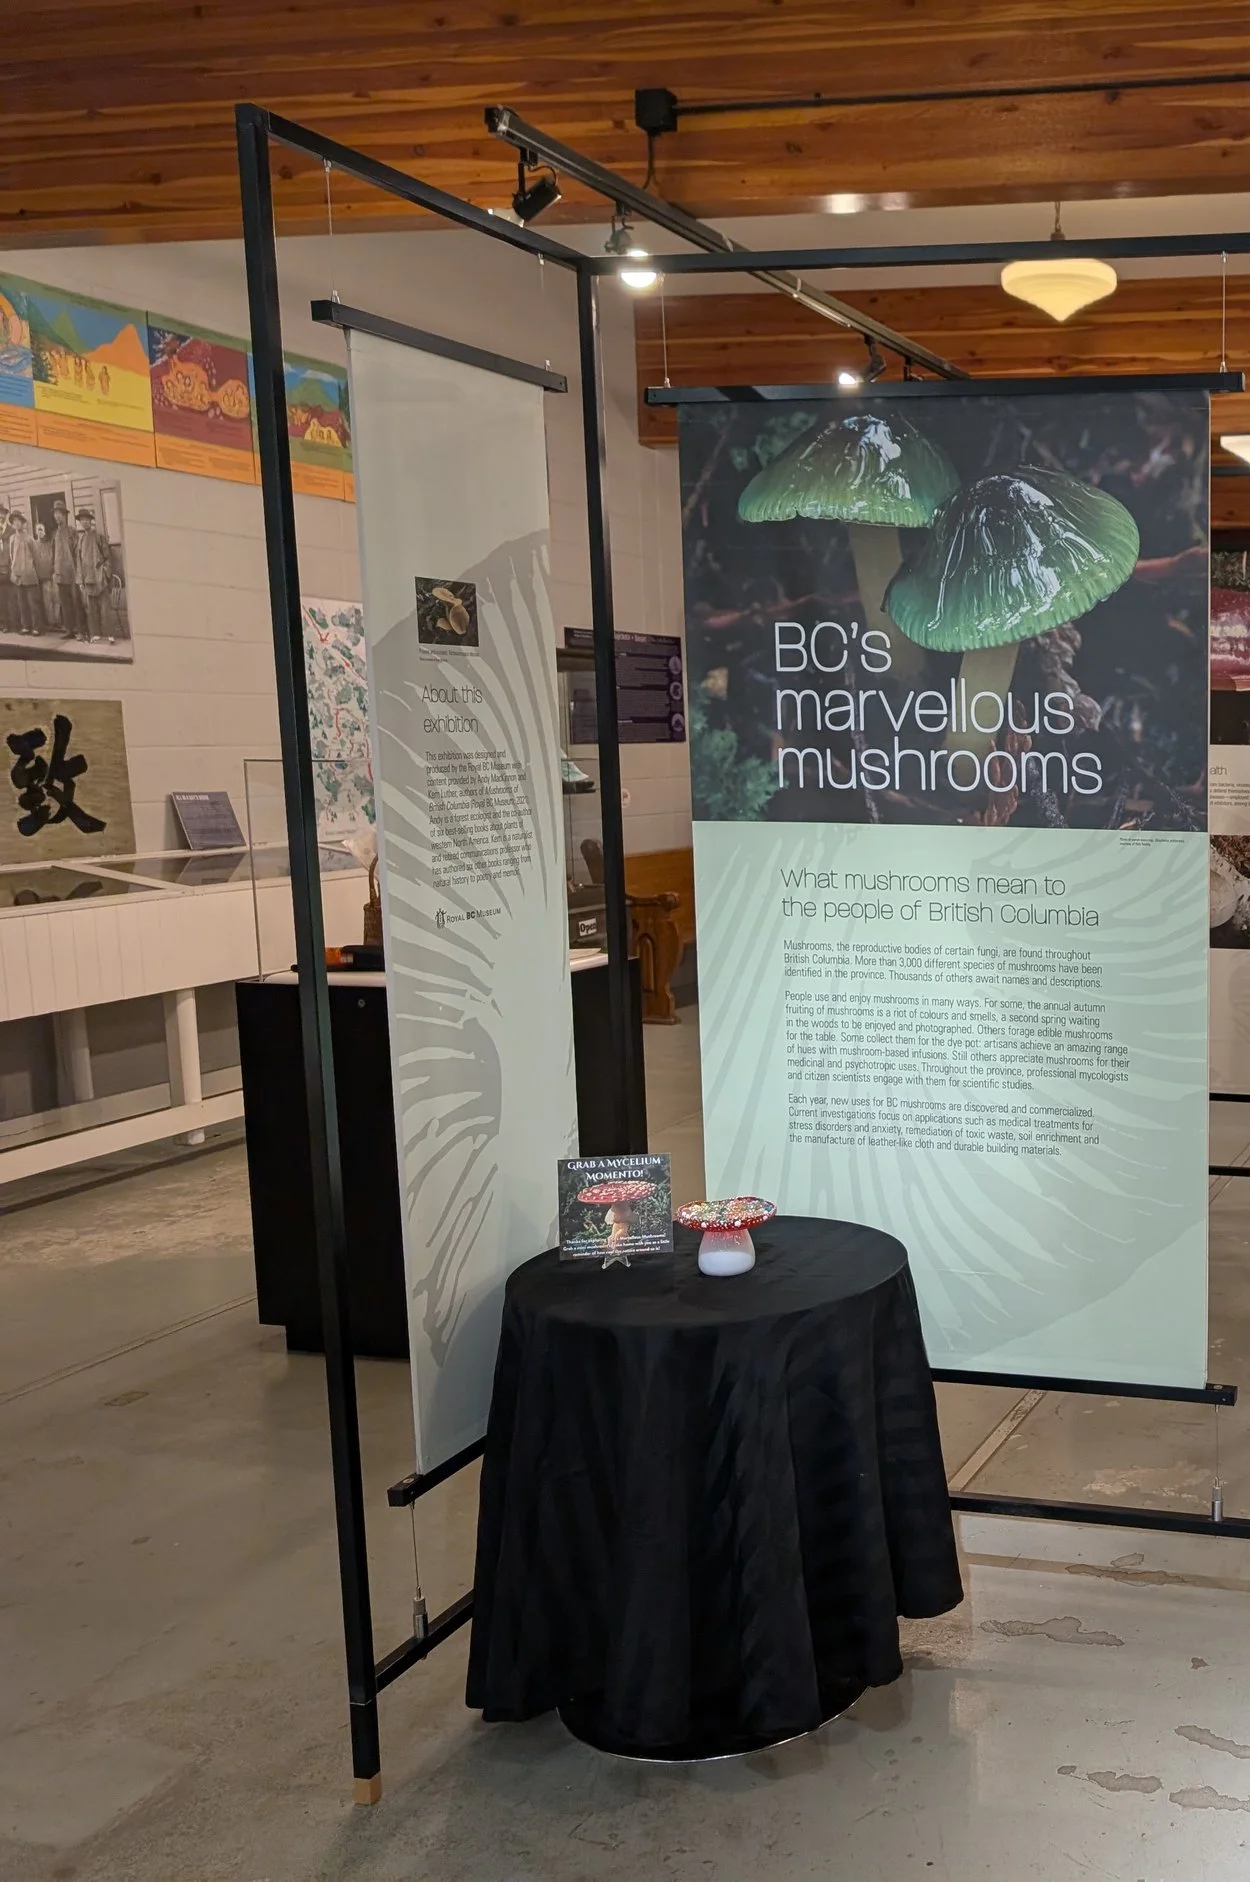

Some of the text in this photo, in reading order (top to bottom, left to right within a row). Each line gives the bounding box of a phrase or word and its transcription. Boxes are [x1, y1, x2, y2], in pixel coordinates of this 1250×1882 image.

[774, 621, 891, 673] BC's
[422, 684, 482, 704] About this
[776, 678, 1075, 735] marvellous
[423, 715, 478, 734] exhibition
[425, 751, 436, 760] This
[437, 750, 462, 760] exhibition
[777, 736, 1103, 795] mushrooms
[6, 713, 108, 837] 致
[1209, 766, 1227, 775] alth
[780, 867, 1066, 895] What mushrooms mean to
[447, 915, 465, 923] ROYAL
[466, 911, 475, 919] BC
[782, 895, 1099, 926] the people of British Columbia
[783, 940, 833, 952] Mushrooms,
[836, 942, 849, 951] the
[852, 942, 902, 955] reproductive
[904, 944, 930, 954] bodies
[934, 945, 942, 954] of
[945, 945, 974, 955] certain
[976, 946, 1000, 959] fungi,
[1019, 948, 1042, 958] found
[1045, 949, 1090, 962] throughout
[784, 953, 1102, 973] British Columbia. More than 3,000 different species of mushrooms have been
[784, 966, 821, 976] identified
[825, 968, 831, 977] in
[835, 968, 847, 977] the
[851, 968, 886, 981] province.
[889, 970, 932, 980] Thousands
[934, 972, 943, 981] of
[945, 972, 972, 982] others
[975, 973, 998, 983] await
[1031, 975, 1047, 985] and
[1049, 976, 1102, 989] descriptions.
[787, 1056, 824, 1067] medicinal
[827, 1058, 842, 1068] and
[845, 1059, 896, 1072] psychotropic
[922, 1062, 968, 1076] Throughout
[970, 1064, 983, 1074] the
[986, 1065, 1023, 1078] province,
[1026, 1067, 1076, 1080] professional
[1079, 1069, 1128, 1083] mycologists
[787, 1069, 1034, 1089] and citizen scientists engage with them for scientific studies.
[789, 1133, 1062, 1155] the manufacture of leather-like cloth and durable building materials.
[567, 1156, 661, 1170] GRAB A MYCELIUM
[586, 1170, 644, 1181] MOMENTO!
